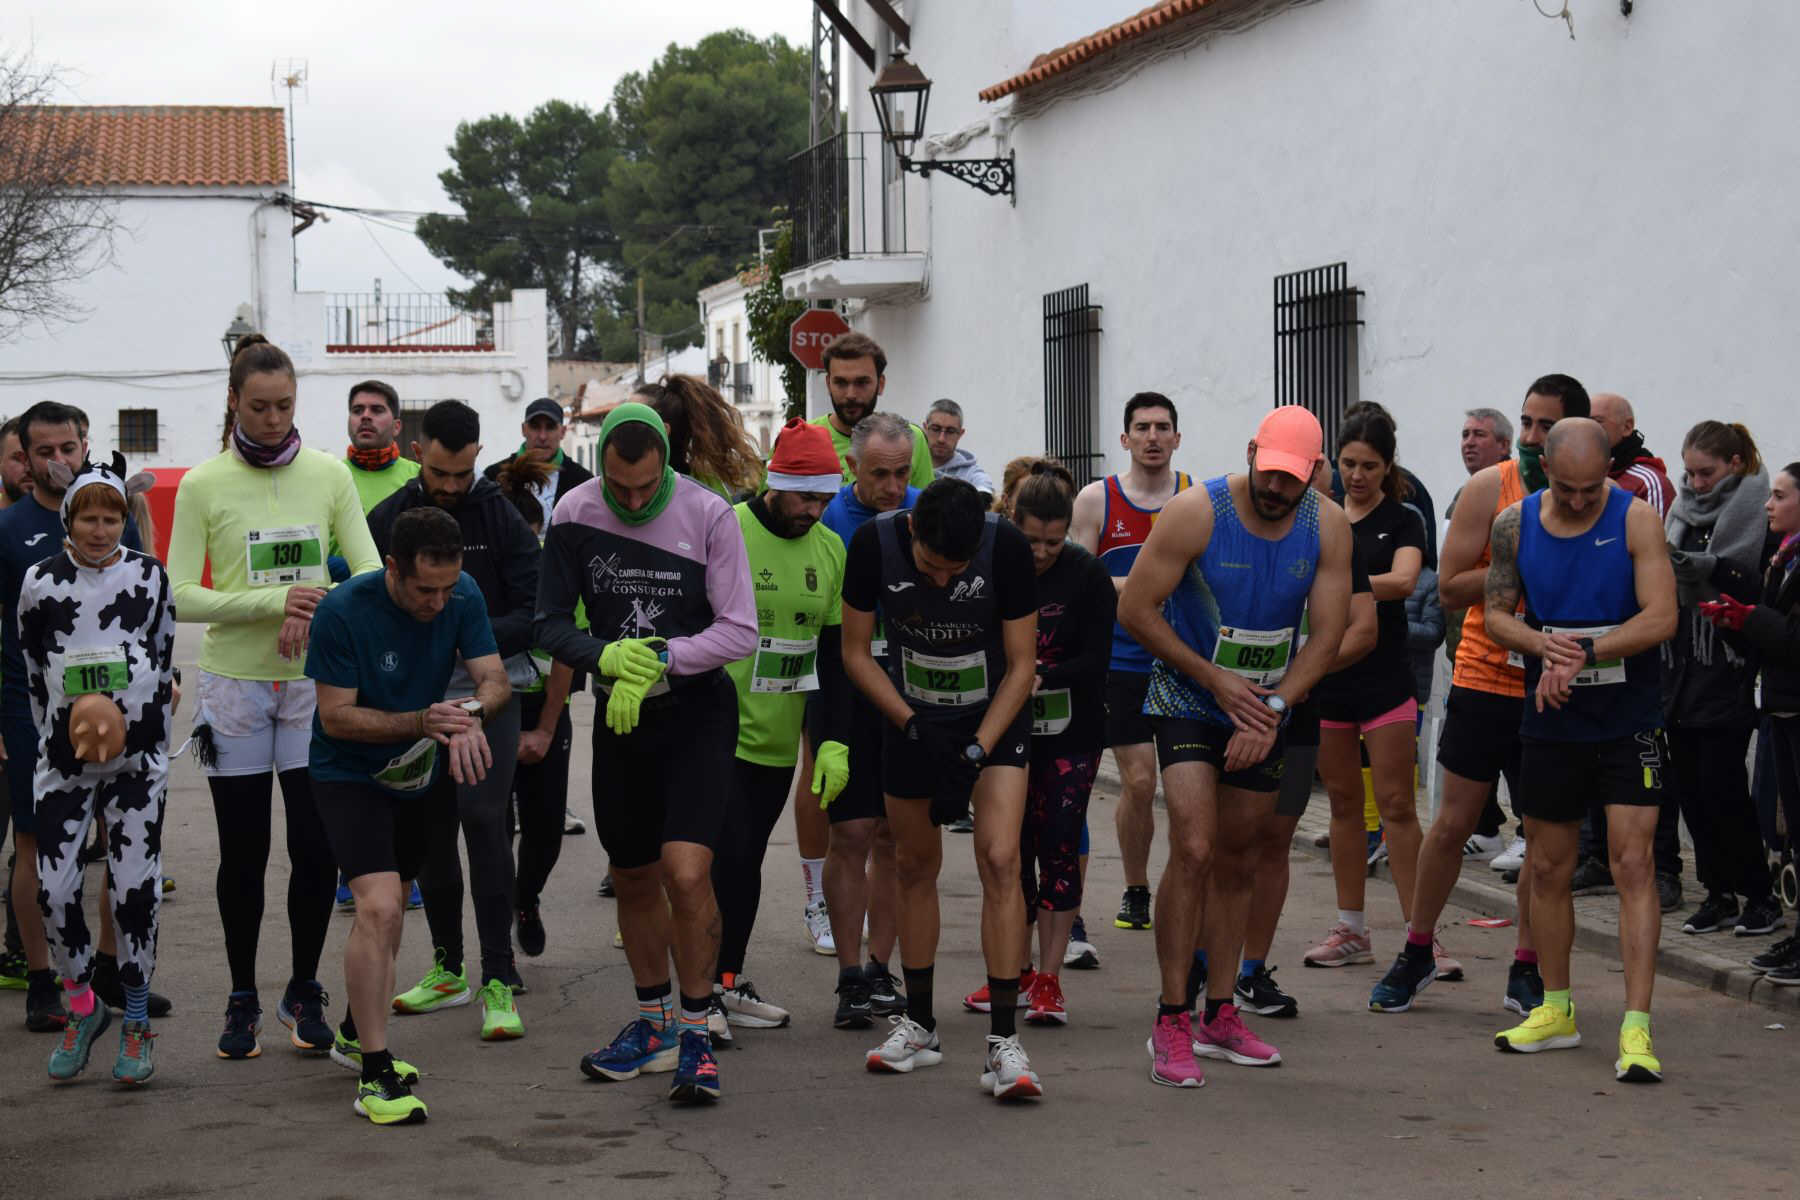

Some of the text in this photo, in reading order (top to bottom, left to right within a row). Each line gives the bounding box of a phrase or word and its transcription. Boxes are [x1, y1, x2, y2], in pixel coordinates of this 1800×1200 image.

[796, 332, 837, 347] STO
[272, 543, 302, 566] 130
[618, 569, 681, 580] CARRERA DE NAVIDAD
[612, 585, 683, 597] CONSUEGRA
[1237, 647, 1275, 668] 052
[80, 665, 110, 690] 116
[925, 670, 960, 691] 122
[1633, 728, 1663, 789] FILA
